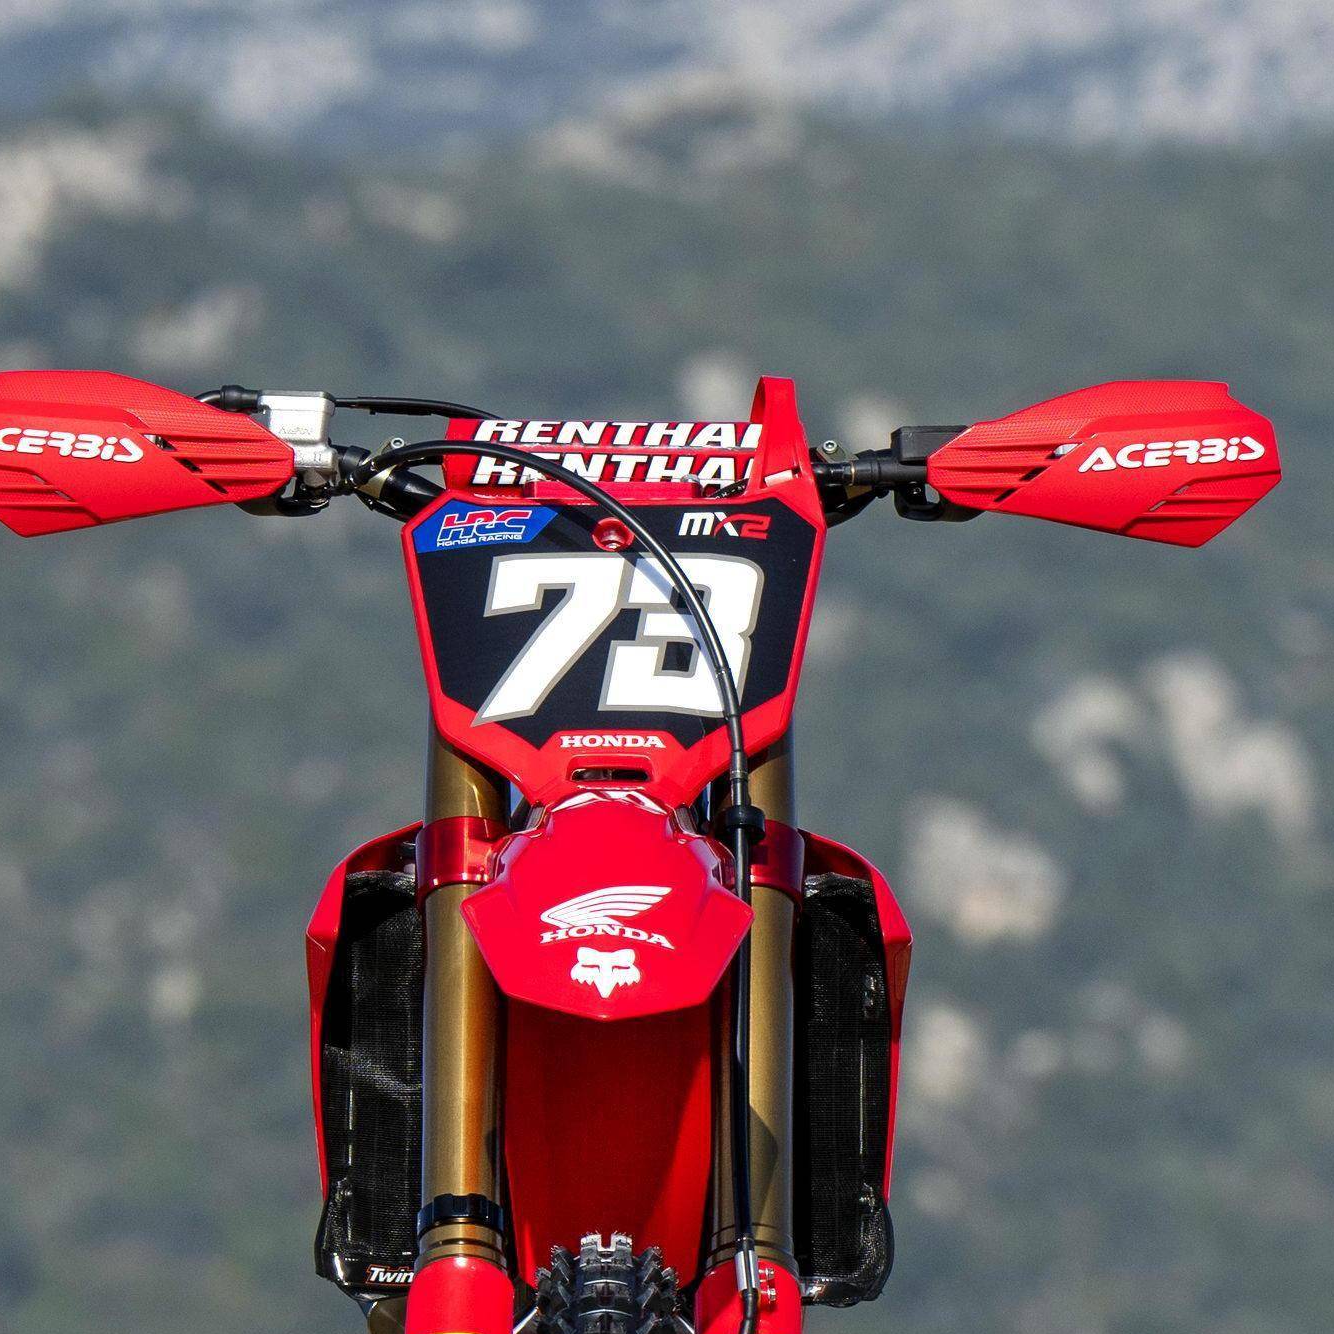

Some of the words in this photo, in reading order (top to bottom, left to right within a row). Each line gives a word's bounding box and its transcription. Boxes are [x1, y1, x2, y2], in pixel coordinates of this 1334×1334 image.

[1077, 436, 1266, 473] ACERBIS
[437, 510, 532, 541] HRC
[478, 534, 523, 543] RACING
[678, 511, 771, 540] MX2
[470, 552, 765, 727] 73
[560, 735, 667, 748] HONDA
[540, 923, 675, 950] HONDA
[369, 1267, 415, 1283] Twin
